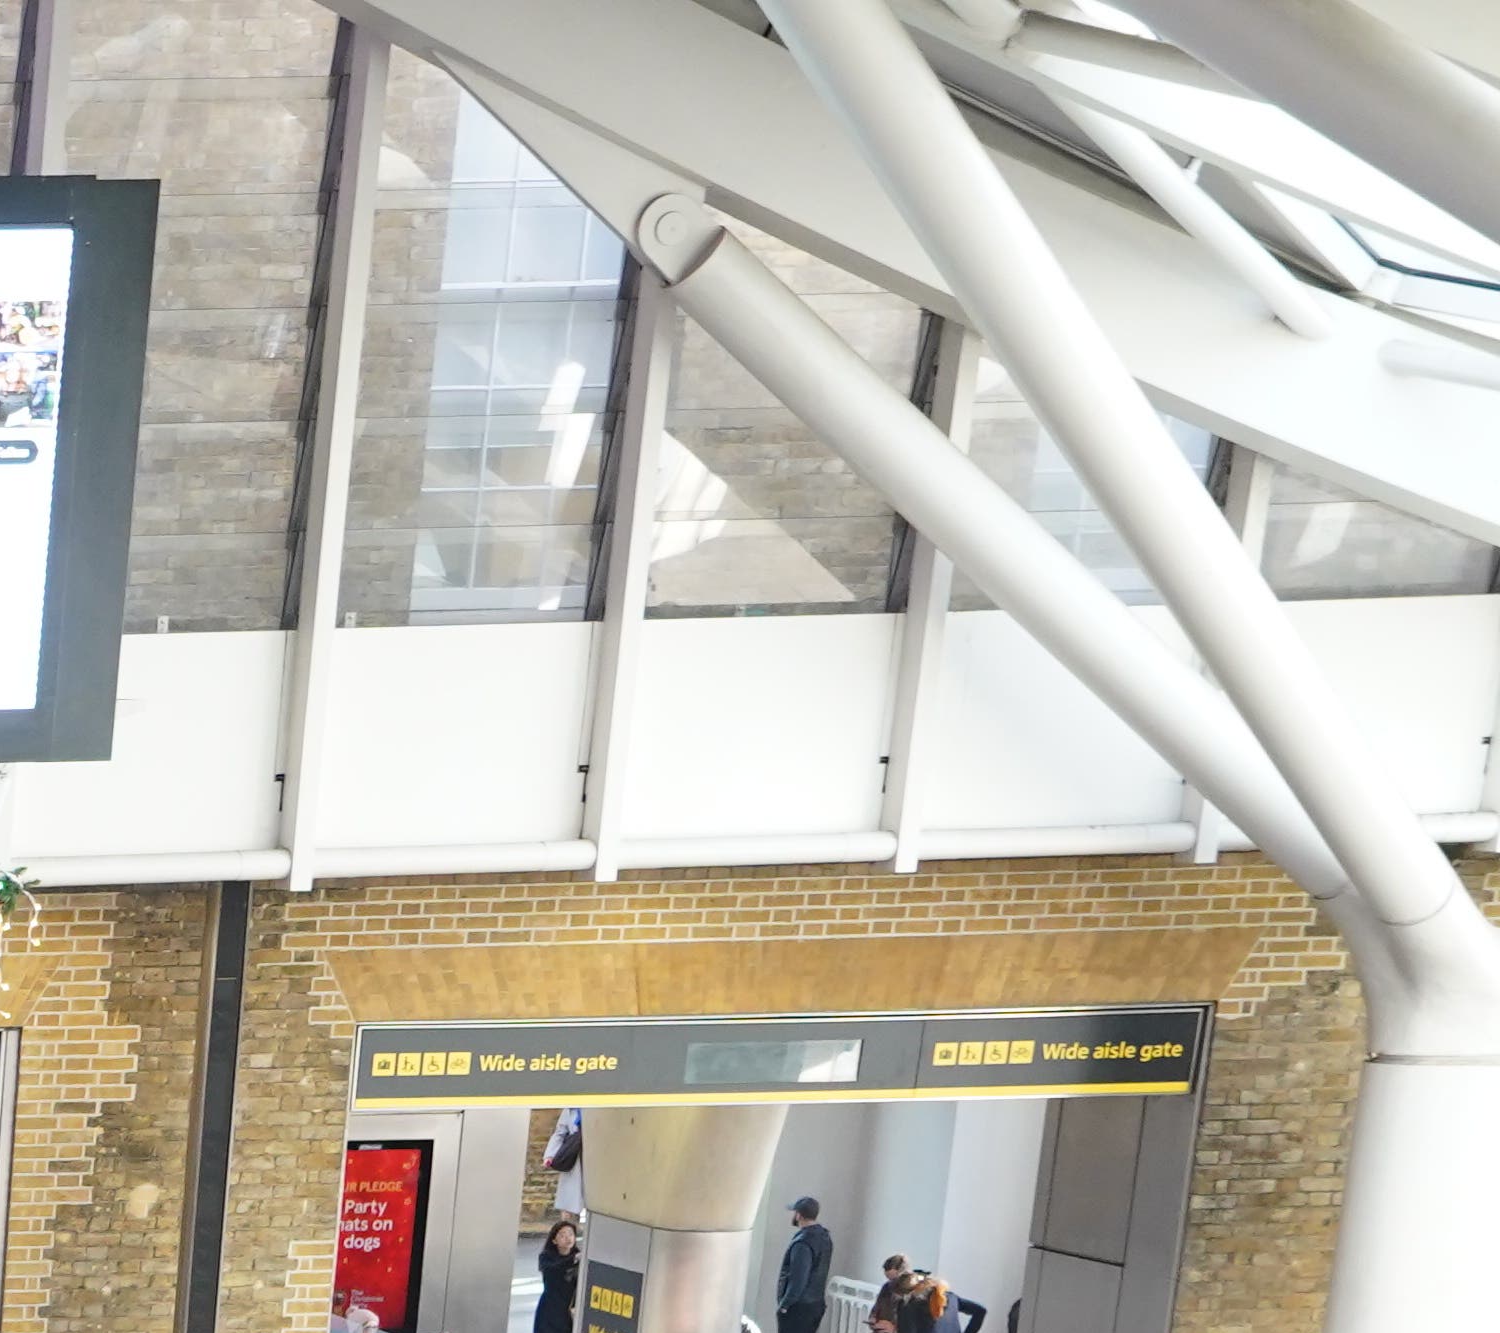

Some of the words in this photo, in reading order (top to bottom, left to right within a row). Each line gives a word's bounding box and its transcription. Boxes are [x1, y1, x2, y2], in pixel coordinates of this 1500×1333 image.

[1043, 1044, 1089, 1058] Wide
[1093, 1042, 1136, 1058] aisle
[1140, 1043, 1183, 1061] gate
[481, 1056, 524, 1070] Wide
[531, 1056, 570, 1069] aisle
[576, 1056, 615, 1073] gate
[359, 1180, 403, 1193] PLEDGE
[344, 1199, 387, 1217] Party
[372, 1218, 393, 1232] on
[343, 1234, 380, 1252] dogs
